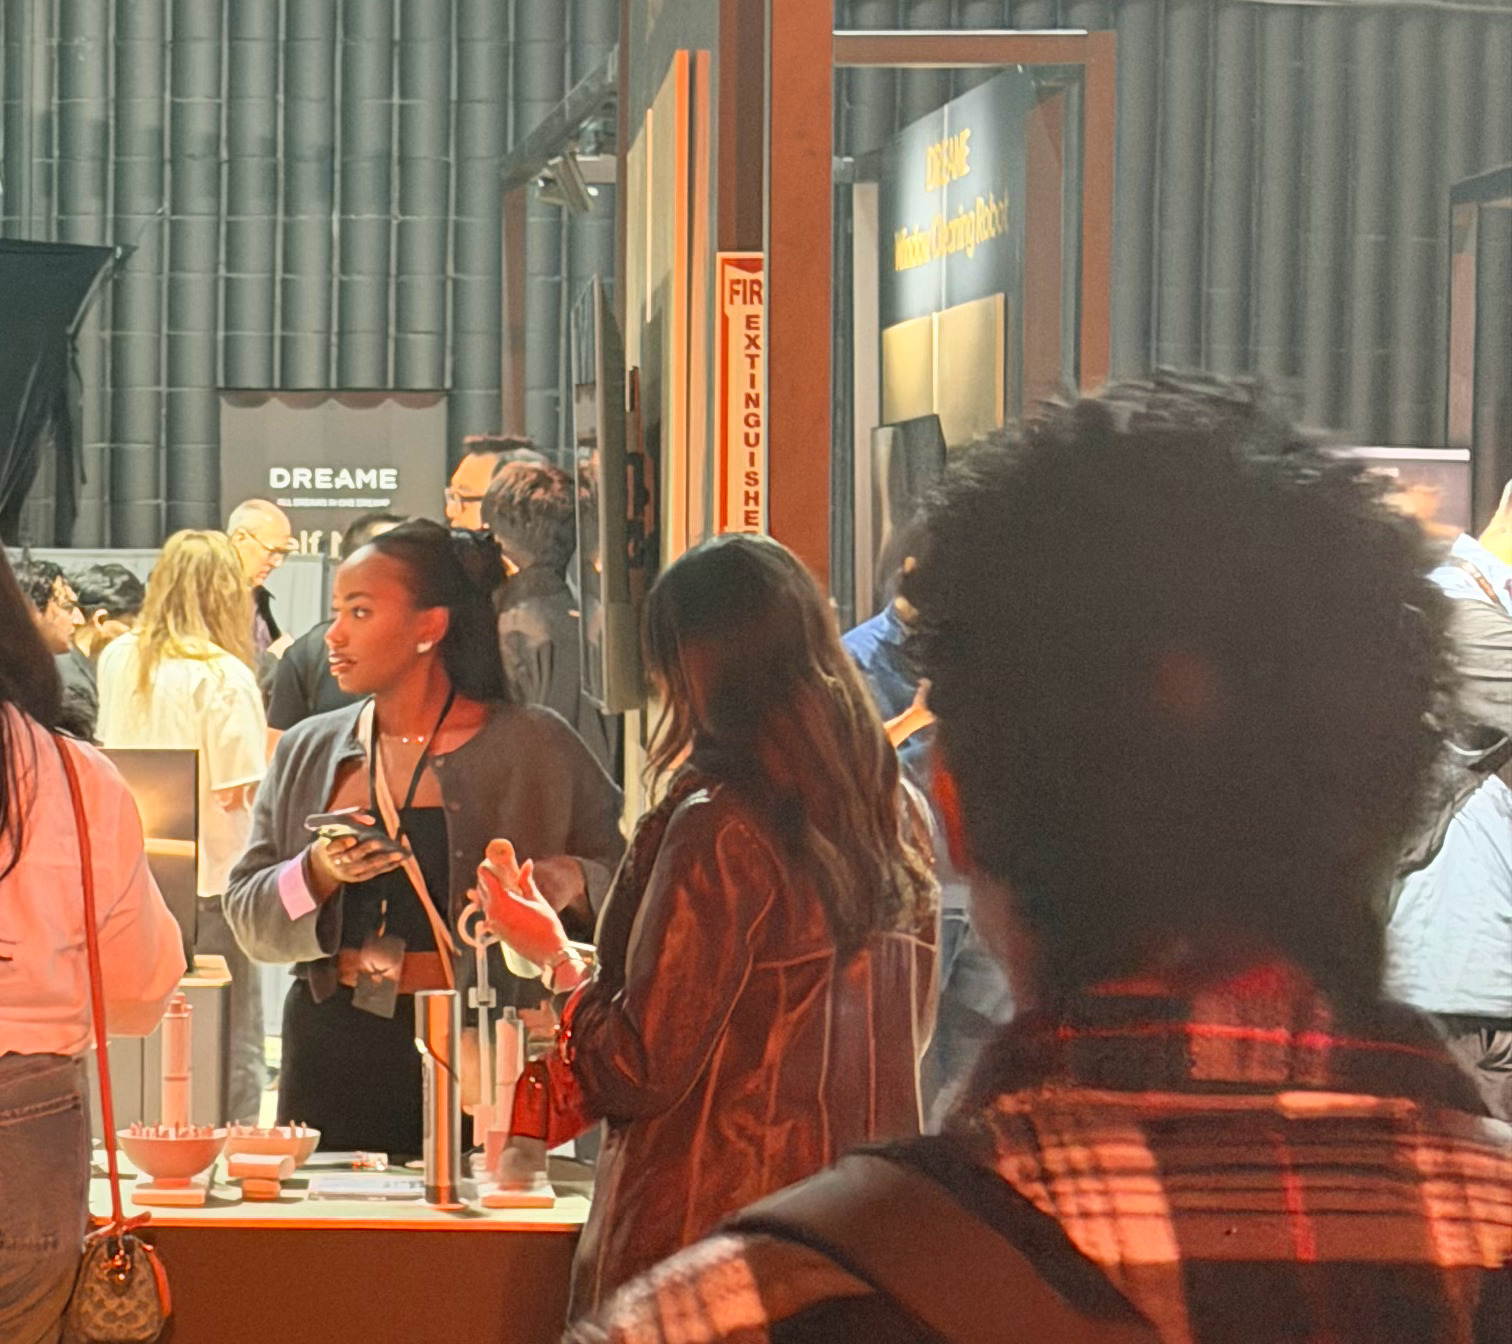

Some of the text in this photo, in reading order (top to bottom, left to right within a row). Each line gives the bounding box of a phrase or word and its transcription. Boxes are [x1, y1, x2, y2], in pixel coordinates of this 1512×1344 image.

[728, 278, 763, 306] FIR
[742, 314, 761, 534] EXTINGUISHE
[269, 467, 398, 490] DREAME
